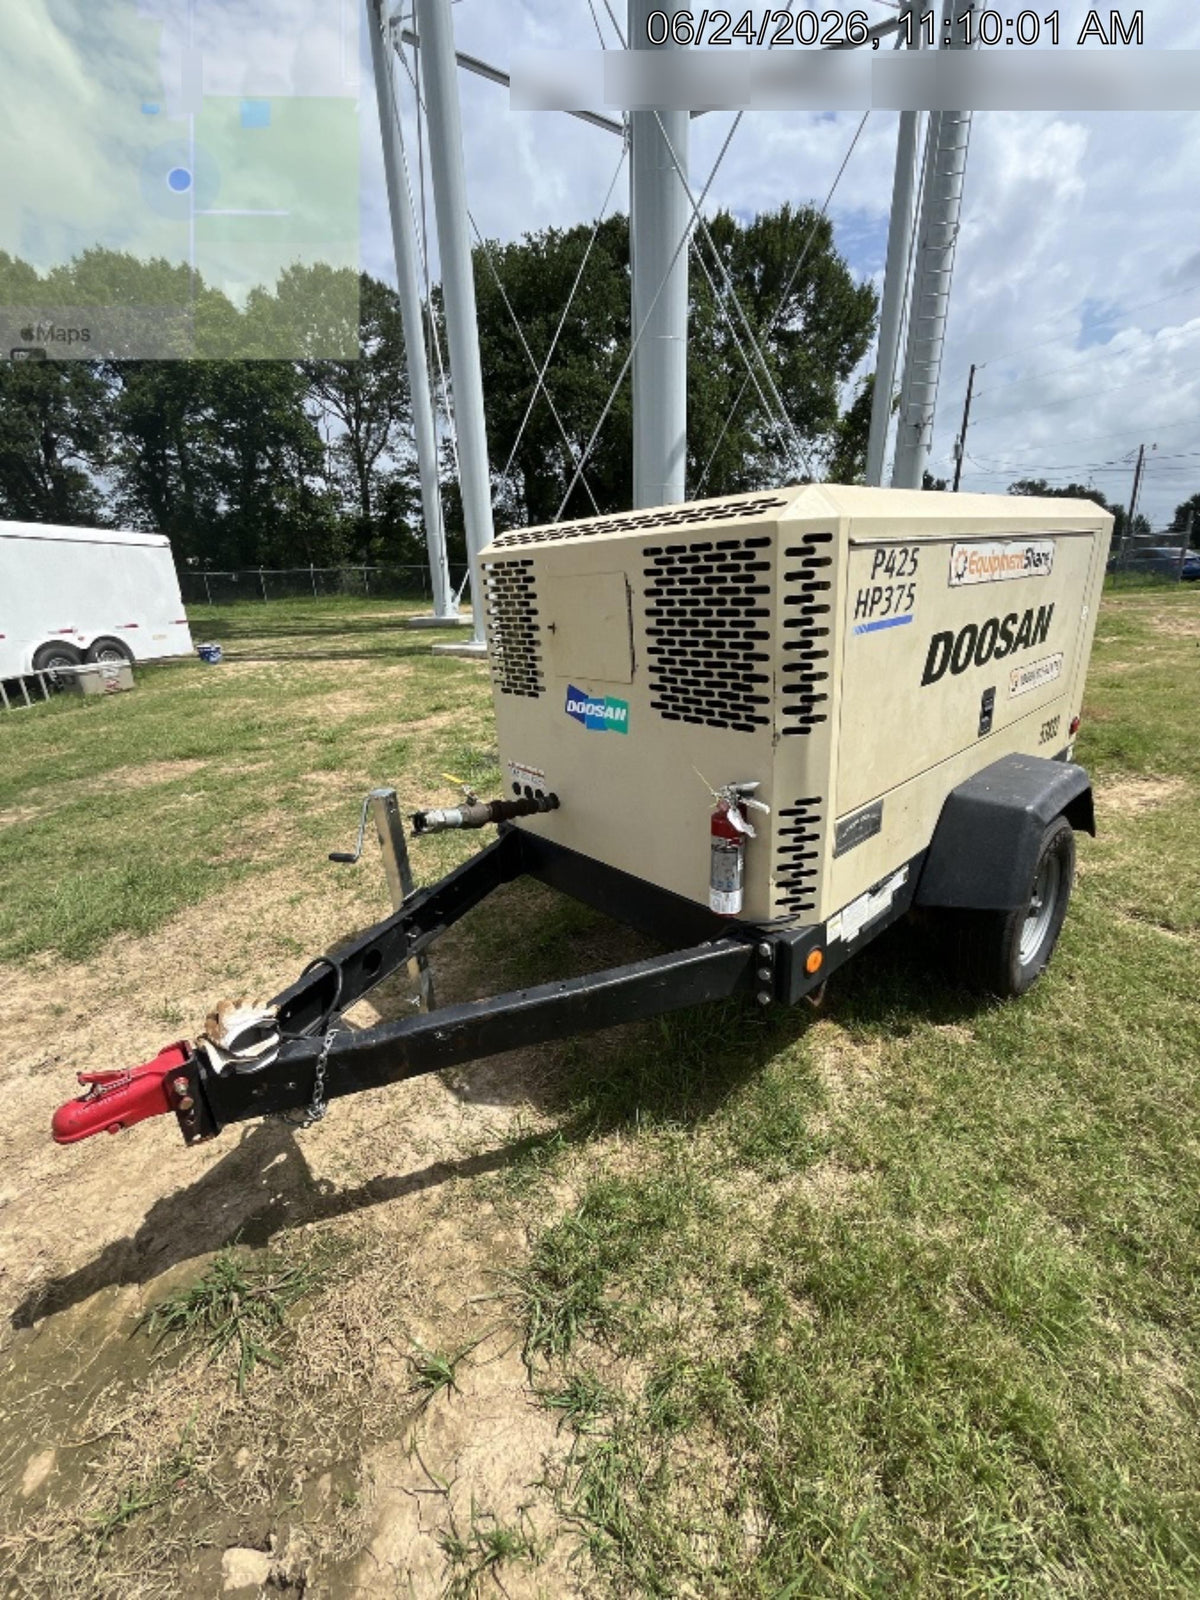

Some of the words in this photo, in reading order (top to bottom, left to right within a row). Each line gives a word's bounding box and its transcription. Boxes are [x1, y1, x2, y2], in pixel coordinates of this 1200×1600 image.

[870, 546, 920, 580] P425
[853, 582, 917, 620] HP375
[920, 602, 1055, 688] DOOSAN
[566, 700, 627, 721] DOOSAN
